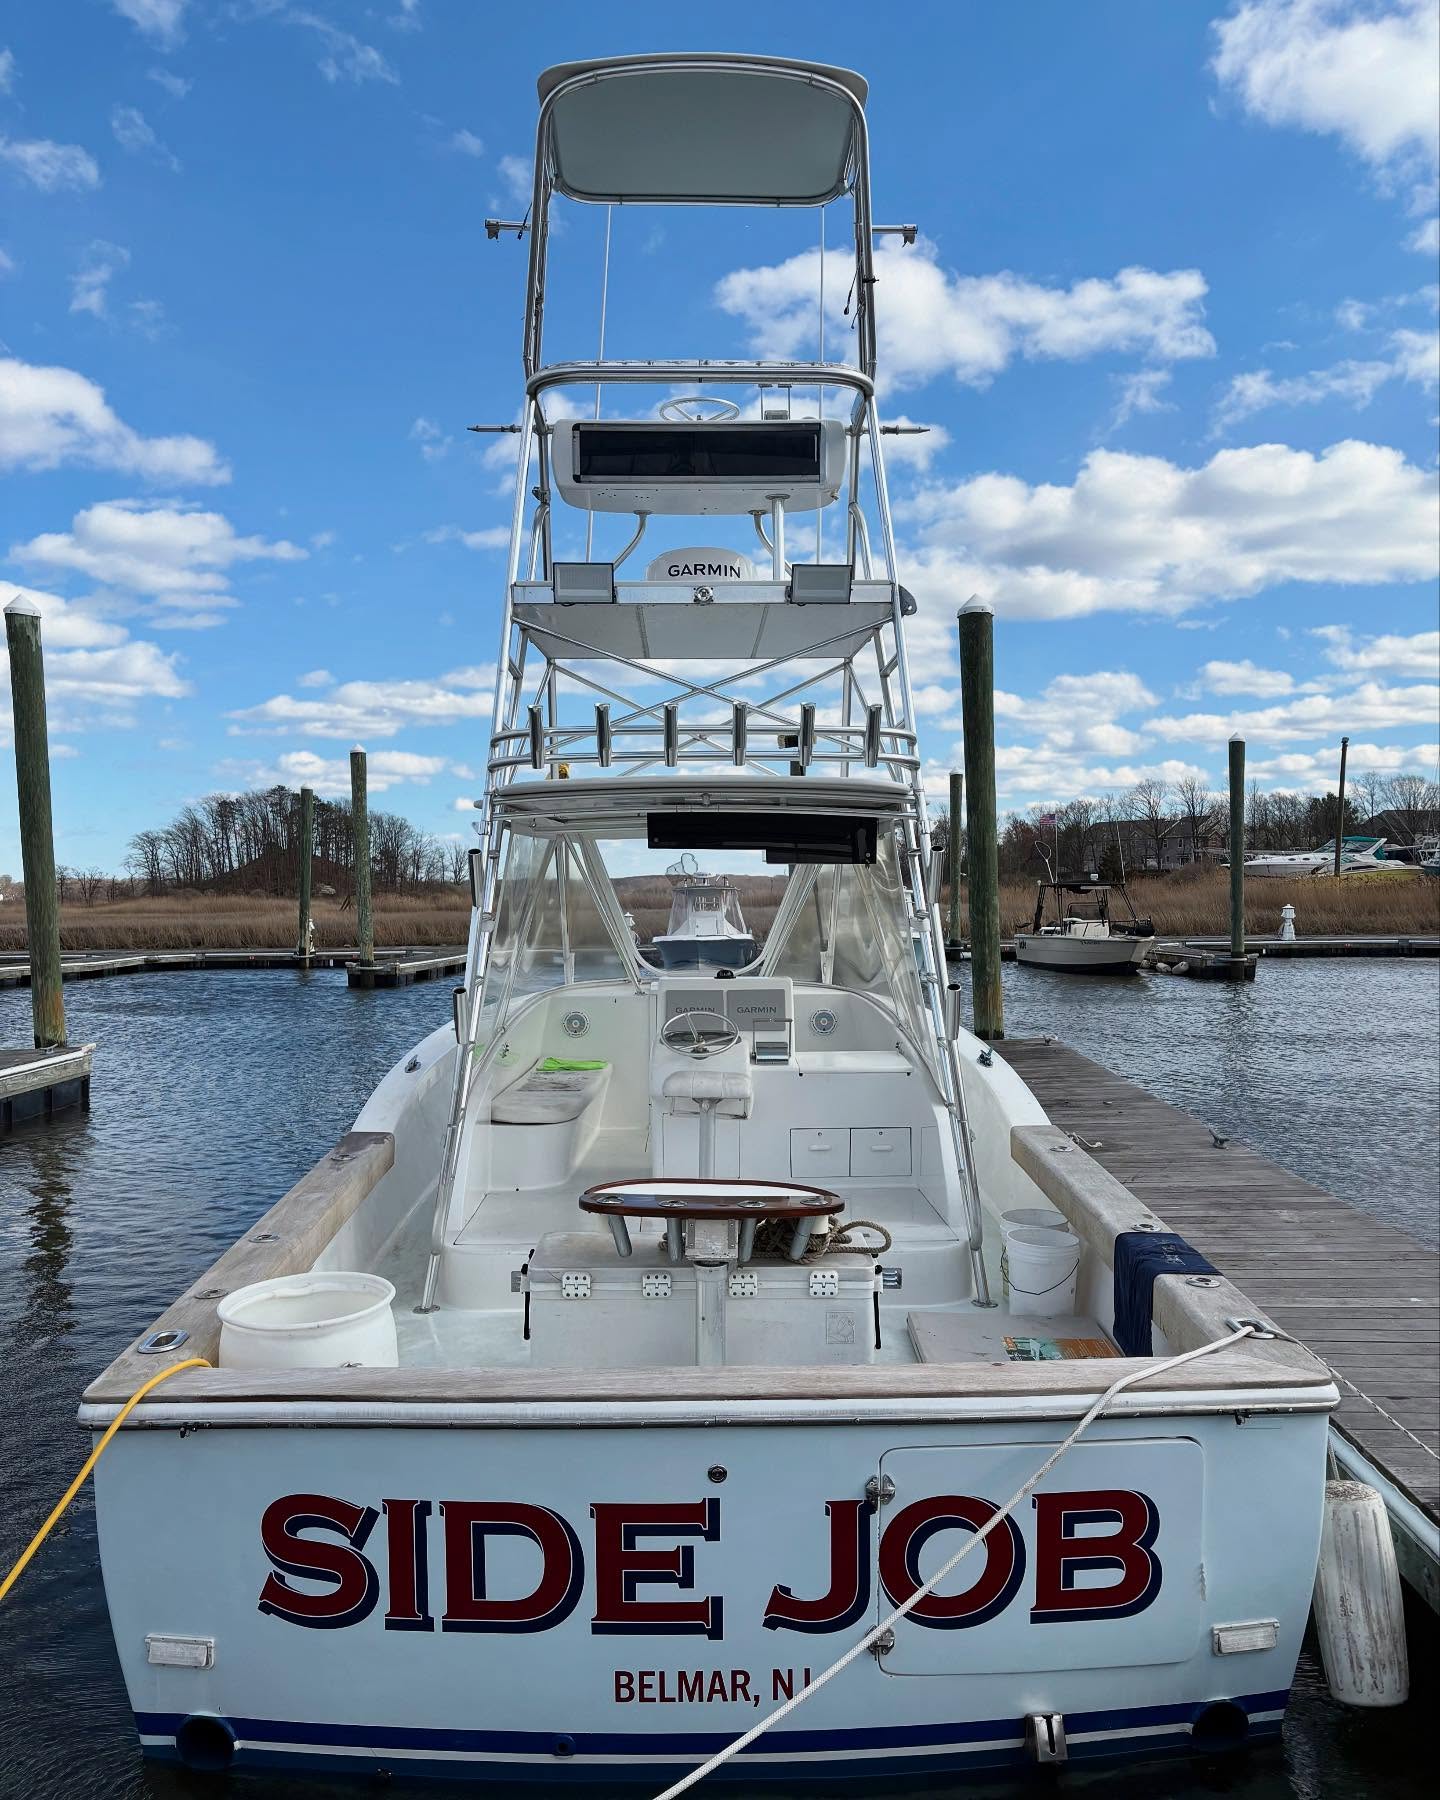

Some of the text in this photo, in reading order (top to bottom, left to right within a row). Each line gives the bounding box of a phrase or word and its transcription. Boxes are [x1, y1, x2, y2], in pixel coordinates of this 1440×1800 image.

[668, 563, 741, 578] GARMIN
[736, 1006, 777, 1014] GARMIN
[257, 1489, 1163, 1641] SIDE JOB
[614, 1669, 760, 1707] BELMAR,
